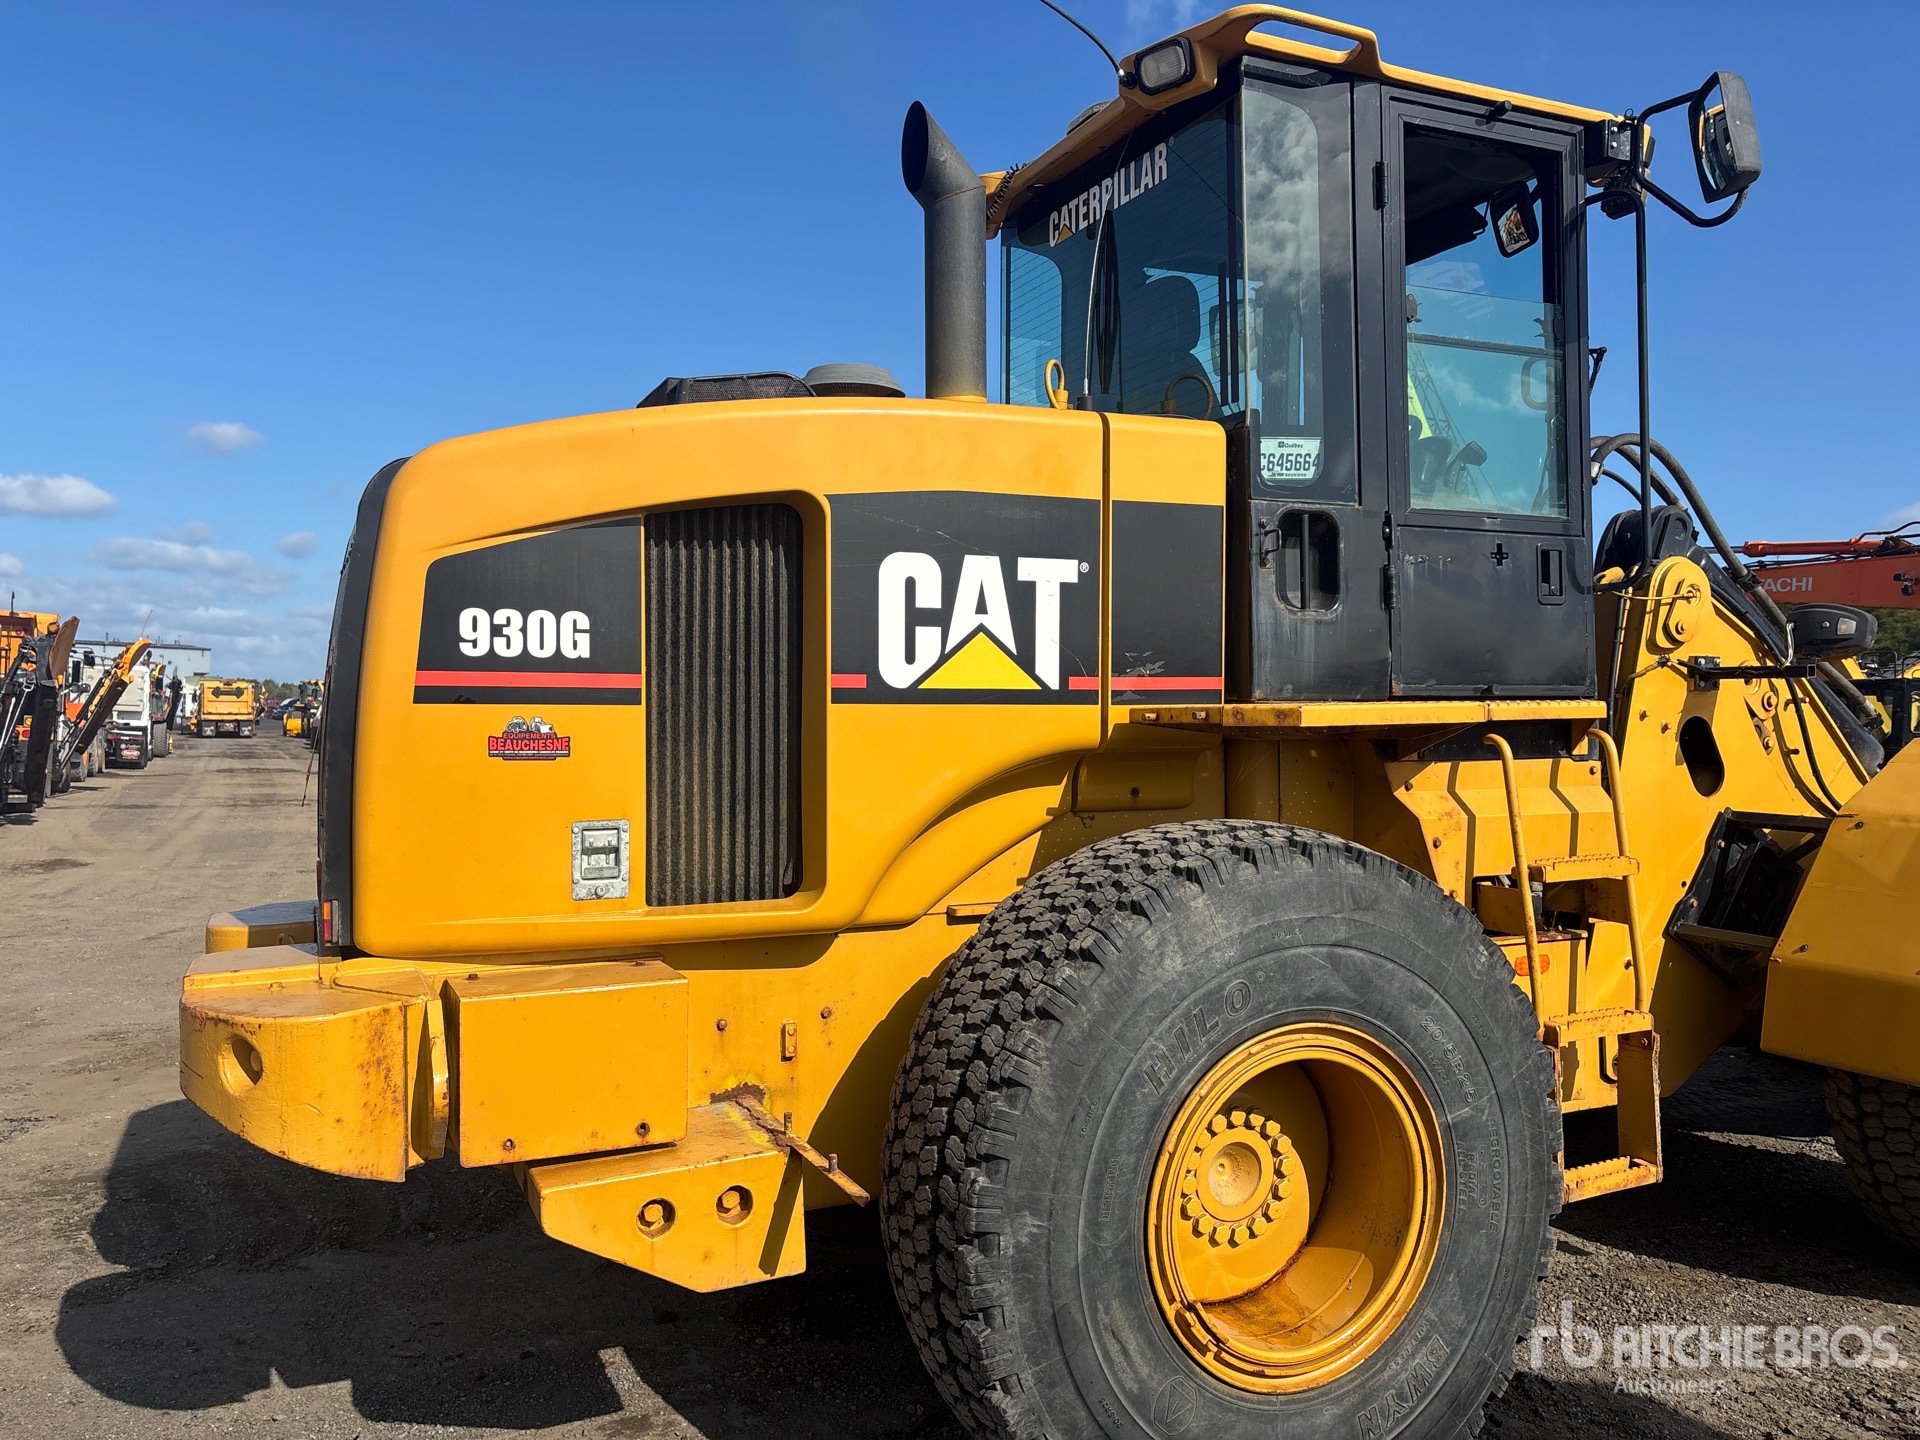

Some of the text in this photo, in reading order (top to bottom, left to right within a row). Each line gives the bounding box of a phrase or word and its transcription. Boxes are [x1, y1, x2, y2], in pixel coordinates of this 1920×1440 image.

[1048, 141, 1168, 247] CATERPILLAR
[1761, 576, 1813, 592] ACHI
[458, 607, 591, 659] 930G
[489, 736, 569, 751] BEAUCHESNE
[1143, 979, 1251, 1096] HILO
[1455, 1140, 1469, 1215] ALL STEEL
[1466, 1152, 1477, 1201] RADIAL
[1487, 1116, 1503, 1234] REGROOVABLE
